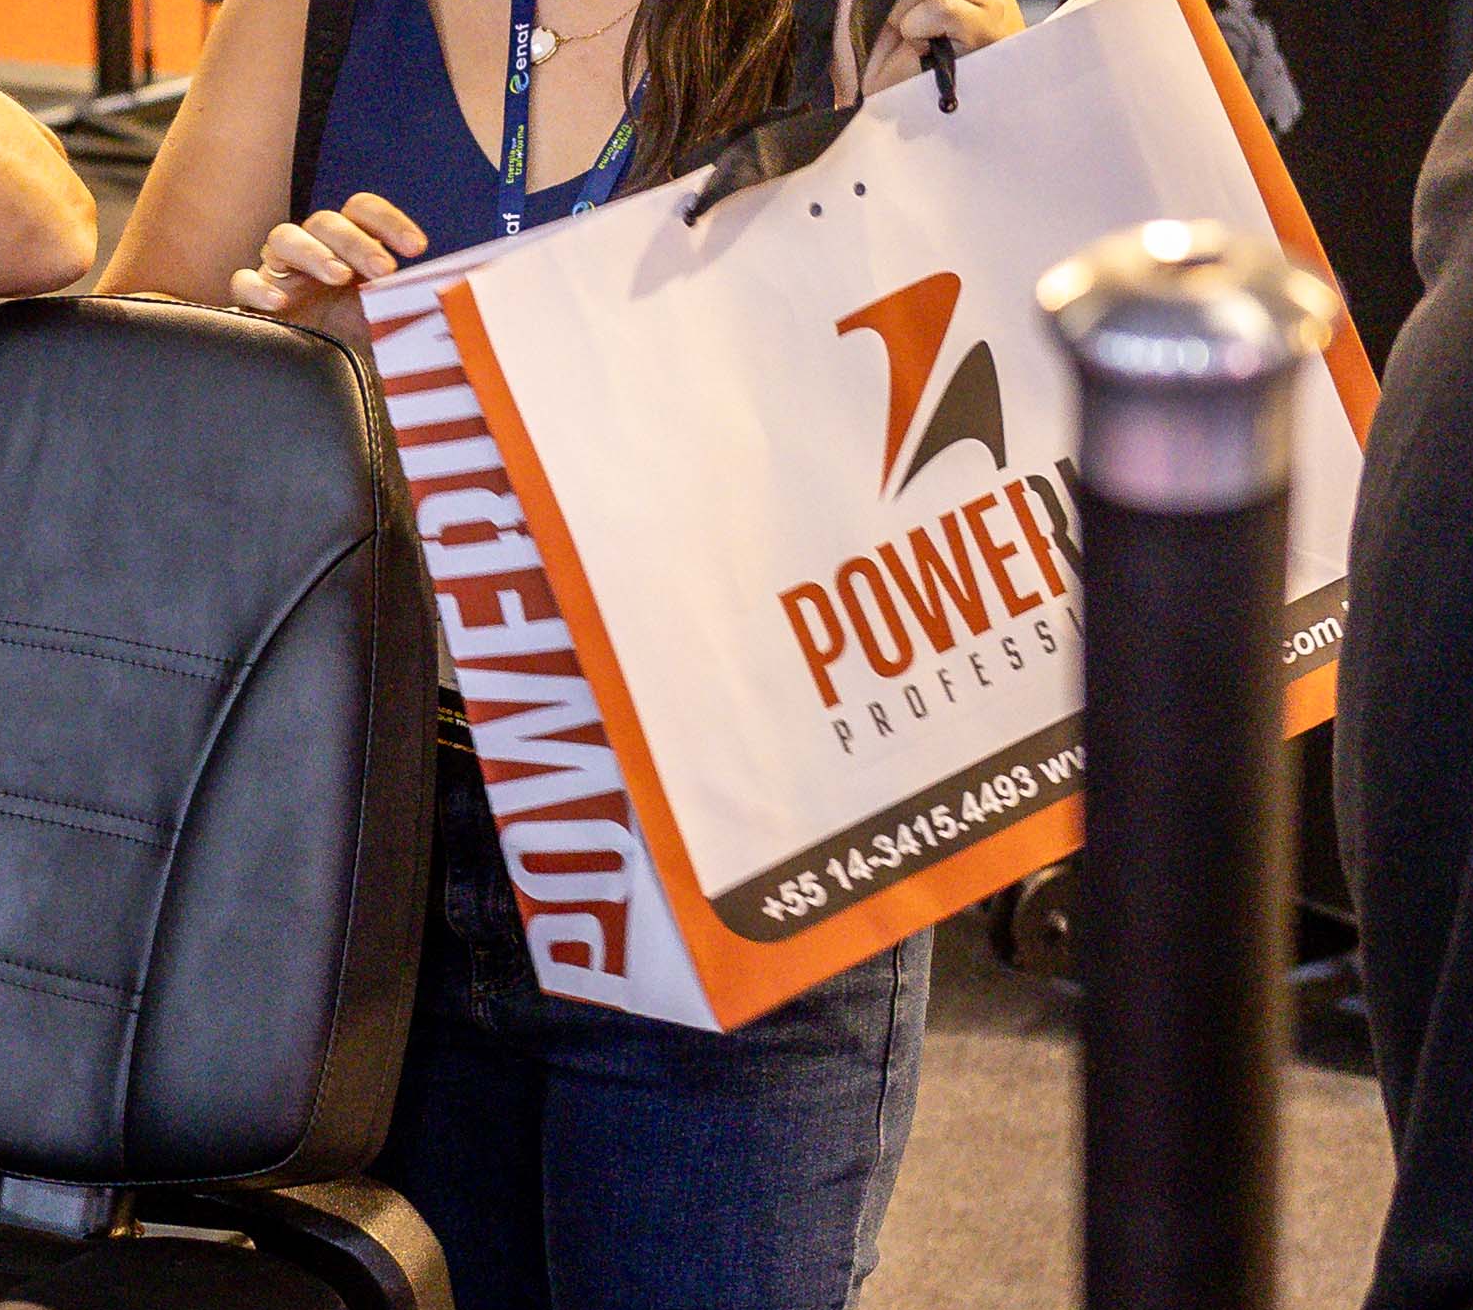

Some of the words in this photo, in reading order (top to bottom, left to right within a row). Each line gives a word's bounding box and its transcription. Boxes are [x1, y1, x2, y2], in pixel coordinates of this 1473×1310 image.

[515, 23, 530, 70] enaf
[502, 212, 521, 236] af
[778, 456, 1081, 711] POWER
[832, 606, 1084, 755] PROFESSI
[762, 870, 828, 922] +55
[826, 764, 1039, 891] 14-3415.4493
[1282, 600, 1349, 664] com
